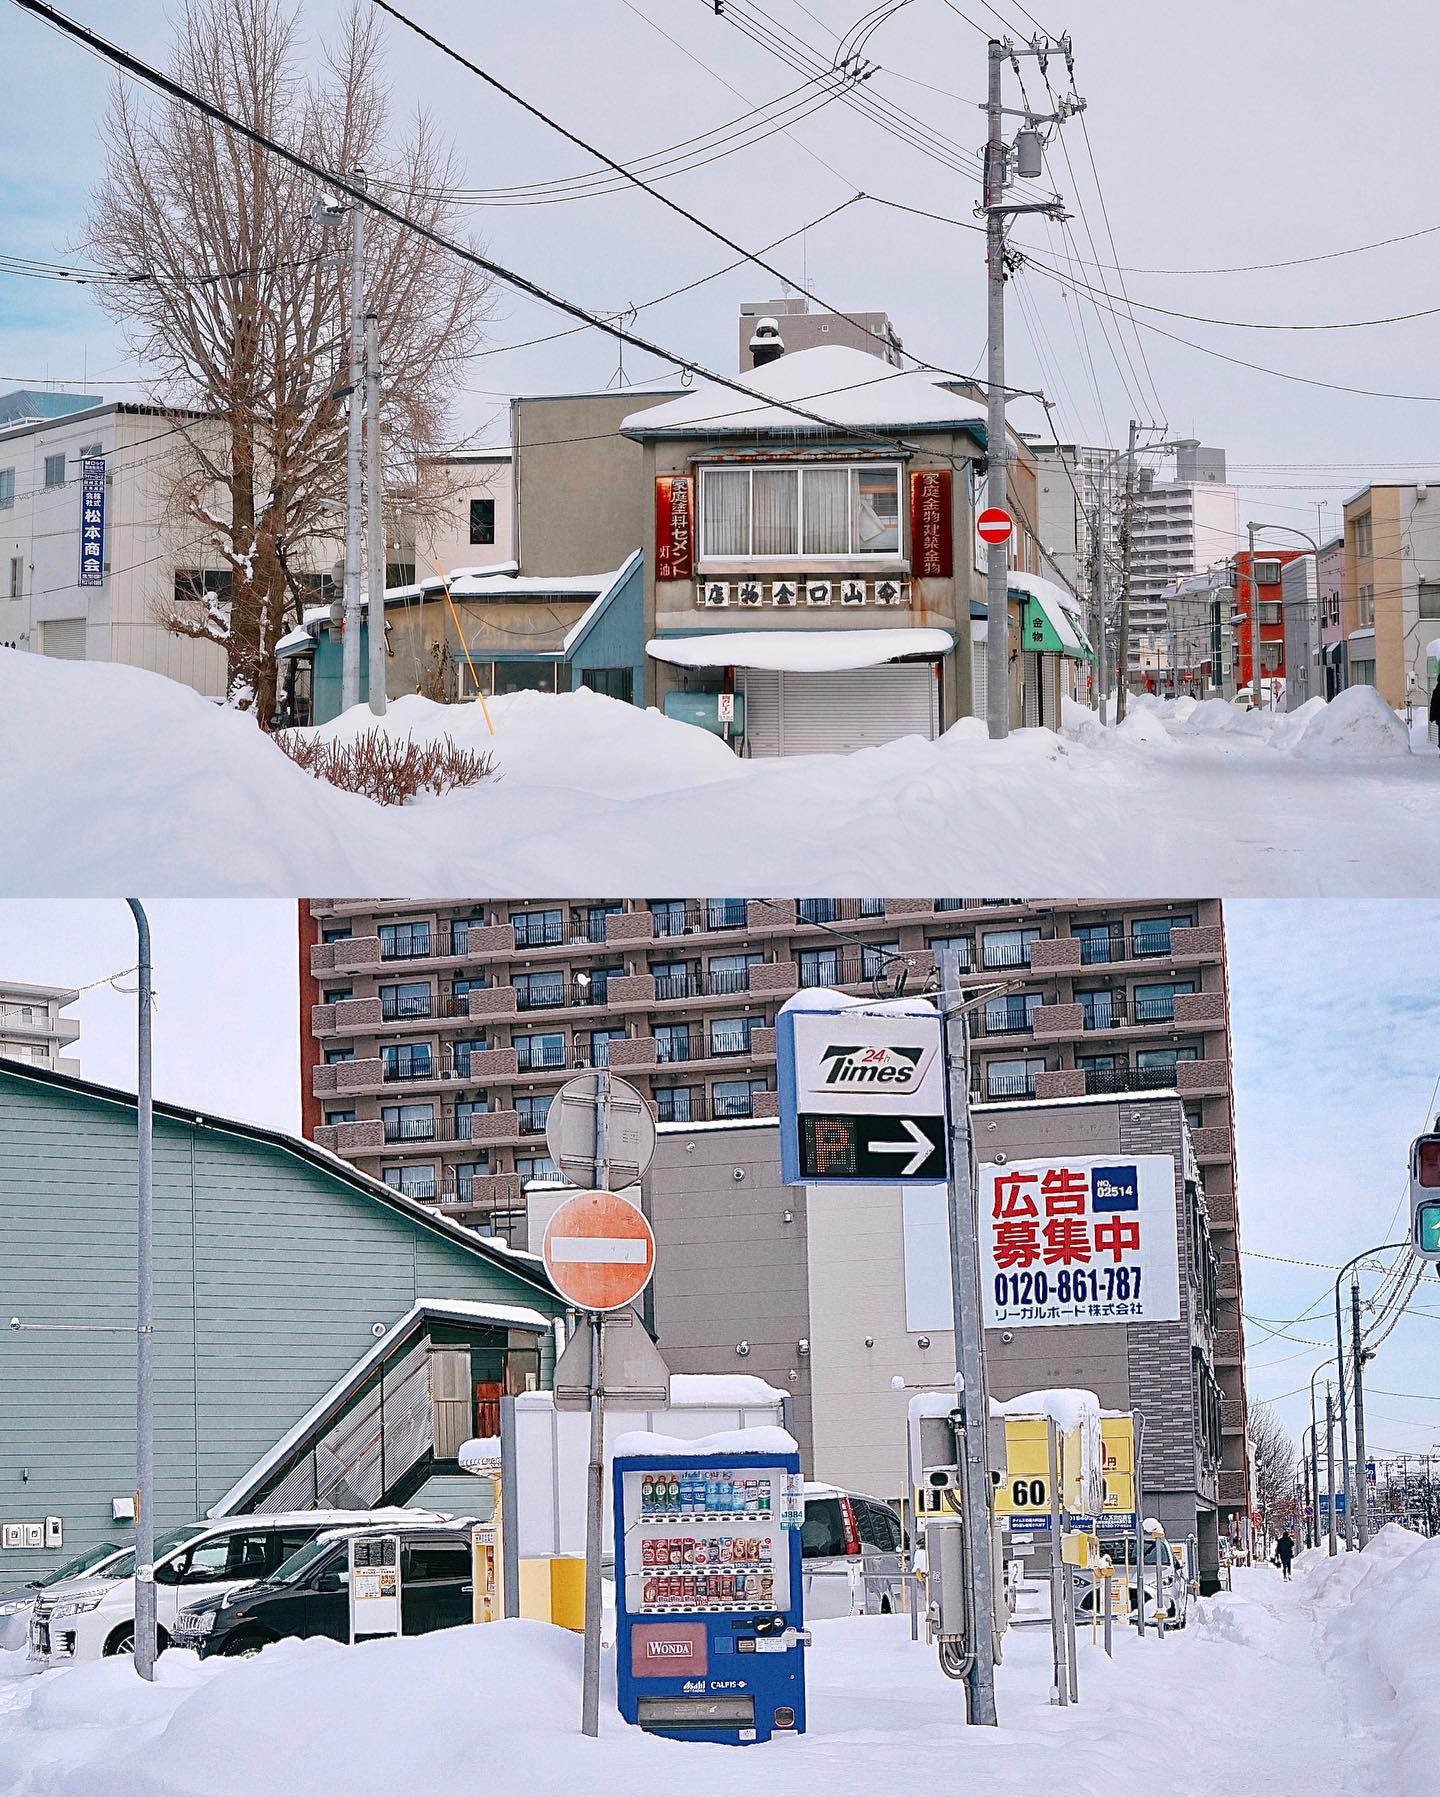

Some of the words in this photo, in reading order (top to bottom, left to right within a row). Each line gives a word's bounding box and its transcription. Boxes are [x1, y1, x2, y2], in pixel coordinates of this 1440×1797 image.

[84, 508, 101, 572] 松本商会
[670, 479, 688, 576] 家庭塗料セメント
[922, 472, 941, 574] 家庭金物建築金物
[660, 545, 670, 576] 灯油
[1032, 617, 1043, 642] 金物
[820, 1046, 924, 1083] Times
[815, 1121, 850, 1172] P
[992, 1168, 1089, 1219] 広告
[1097, 1186, 1133, 1198] 02514
[992, 1215, 1140, 1270] 募集中
[994, 1266, 1142, 1306] 0120-861-787
[1013, 1480, 1045, 1506] 60
[650, 1642, 690, 1654] WONDA
